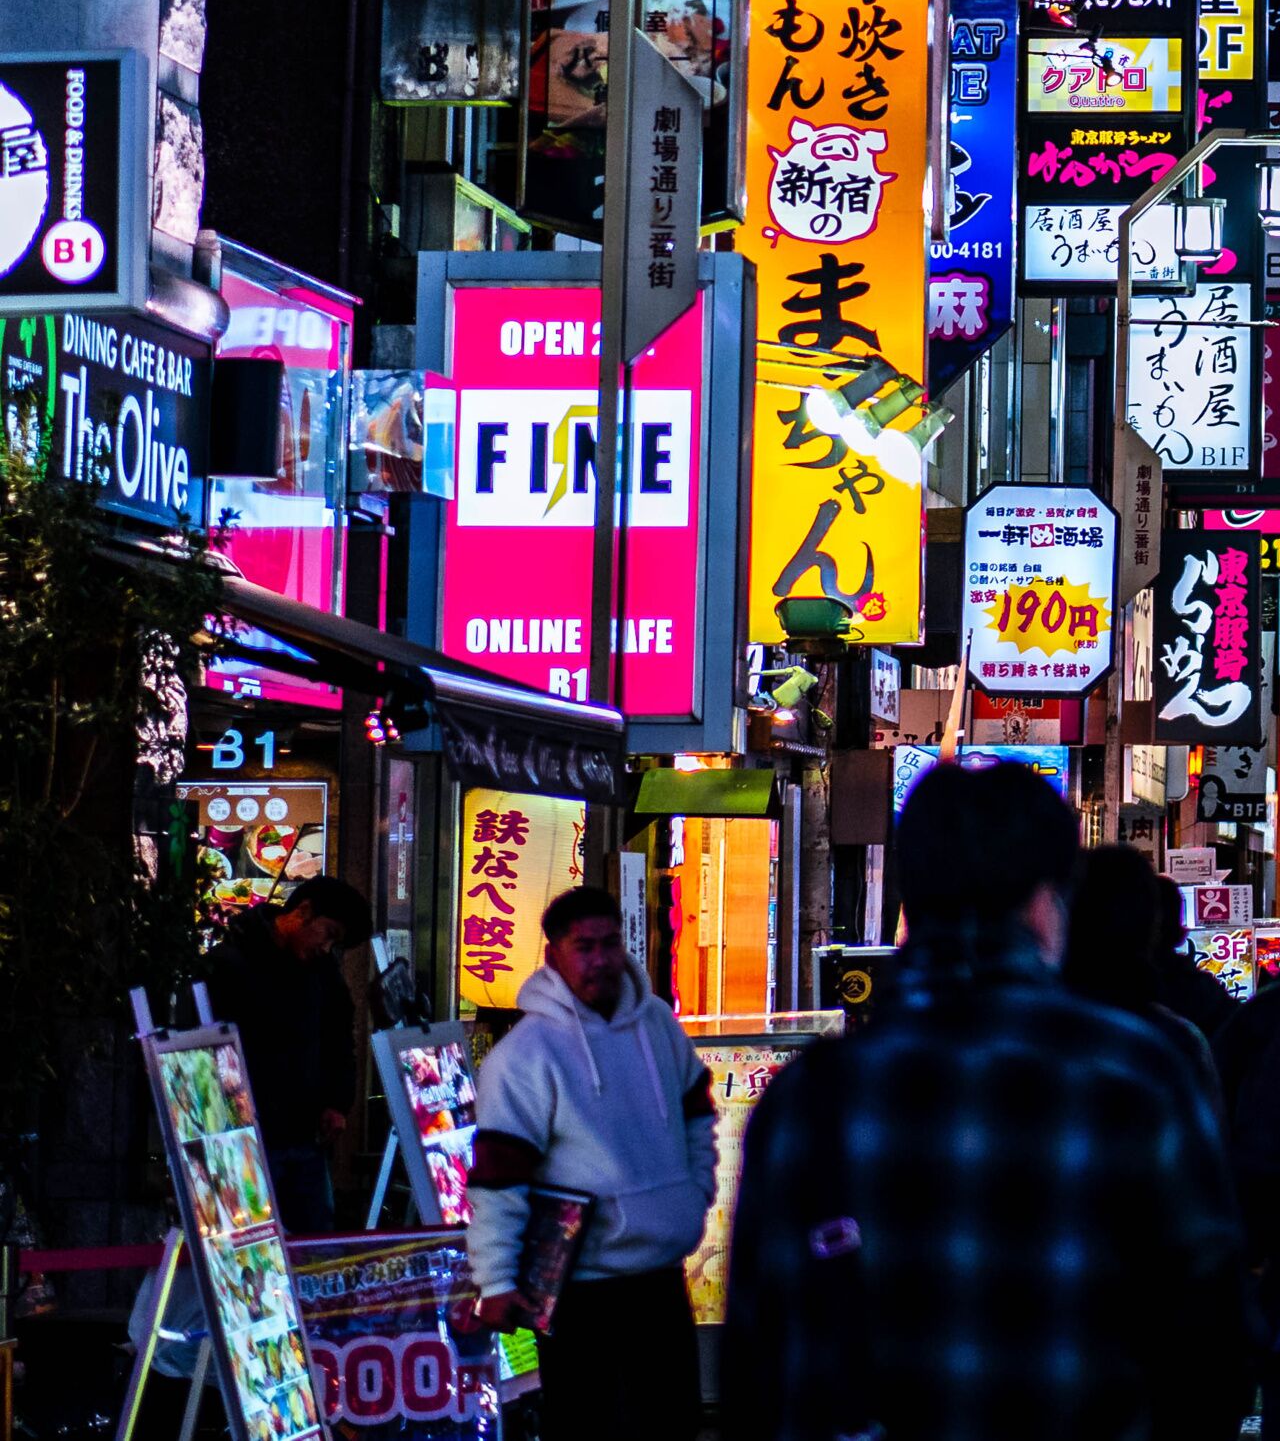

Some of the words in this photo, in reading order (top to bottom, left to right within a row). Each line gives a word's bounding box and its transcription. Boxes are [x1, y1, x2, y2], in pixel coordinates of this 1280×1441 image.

[66, 69, 86, 125] FOOD
[1068, 94, 1125, 108] Quattro
[63, 148, 84, 220] DRINKS
[649, 107, 680, 289] 劇場通り一番街
[1030, 209, 1120, 230] 居酒屋
[53, 238, 92, 264] B1
[1133, 267, 1176, 280] 一番街
[63, 313, 117, 368] DINING
[122, 333, 155, 381] CAFE
[167, 355, 192, 396] BAR
[499, 320, 584, 357] OPEN
[1193, 285, 1240, 426] 居酒屋
[116, 394, 189, 510] Olive
[1201, 447, 1247, 466] B1F
[1134, 465, 1152, 565] 劇場通り一番街
[977, 523, 1104, 549] 一軒め酒場
[970, 590, 997, 604] 激安
[998, 589, 1100, 637] 190円
[1214, 547, 1250, 681] 東京豚骨
[465, 618, 581, 653] ONLINE
[981, 661, 1091, 678] 朝5時まで営業中
[212, 730, 276, 770] B1
[1233, 802, 1265, 817] B1F
[463, 810, 529, 984] 鉄なべ餃子
[1212, 935, 1248, 960] 3F
